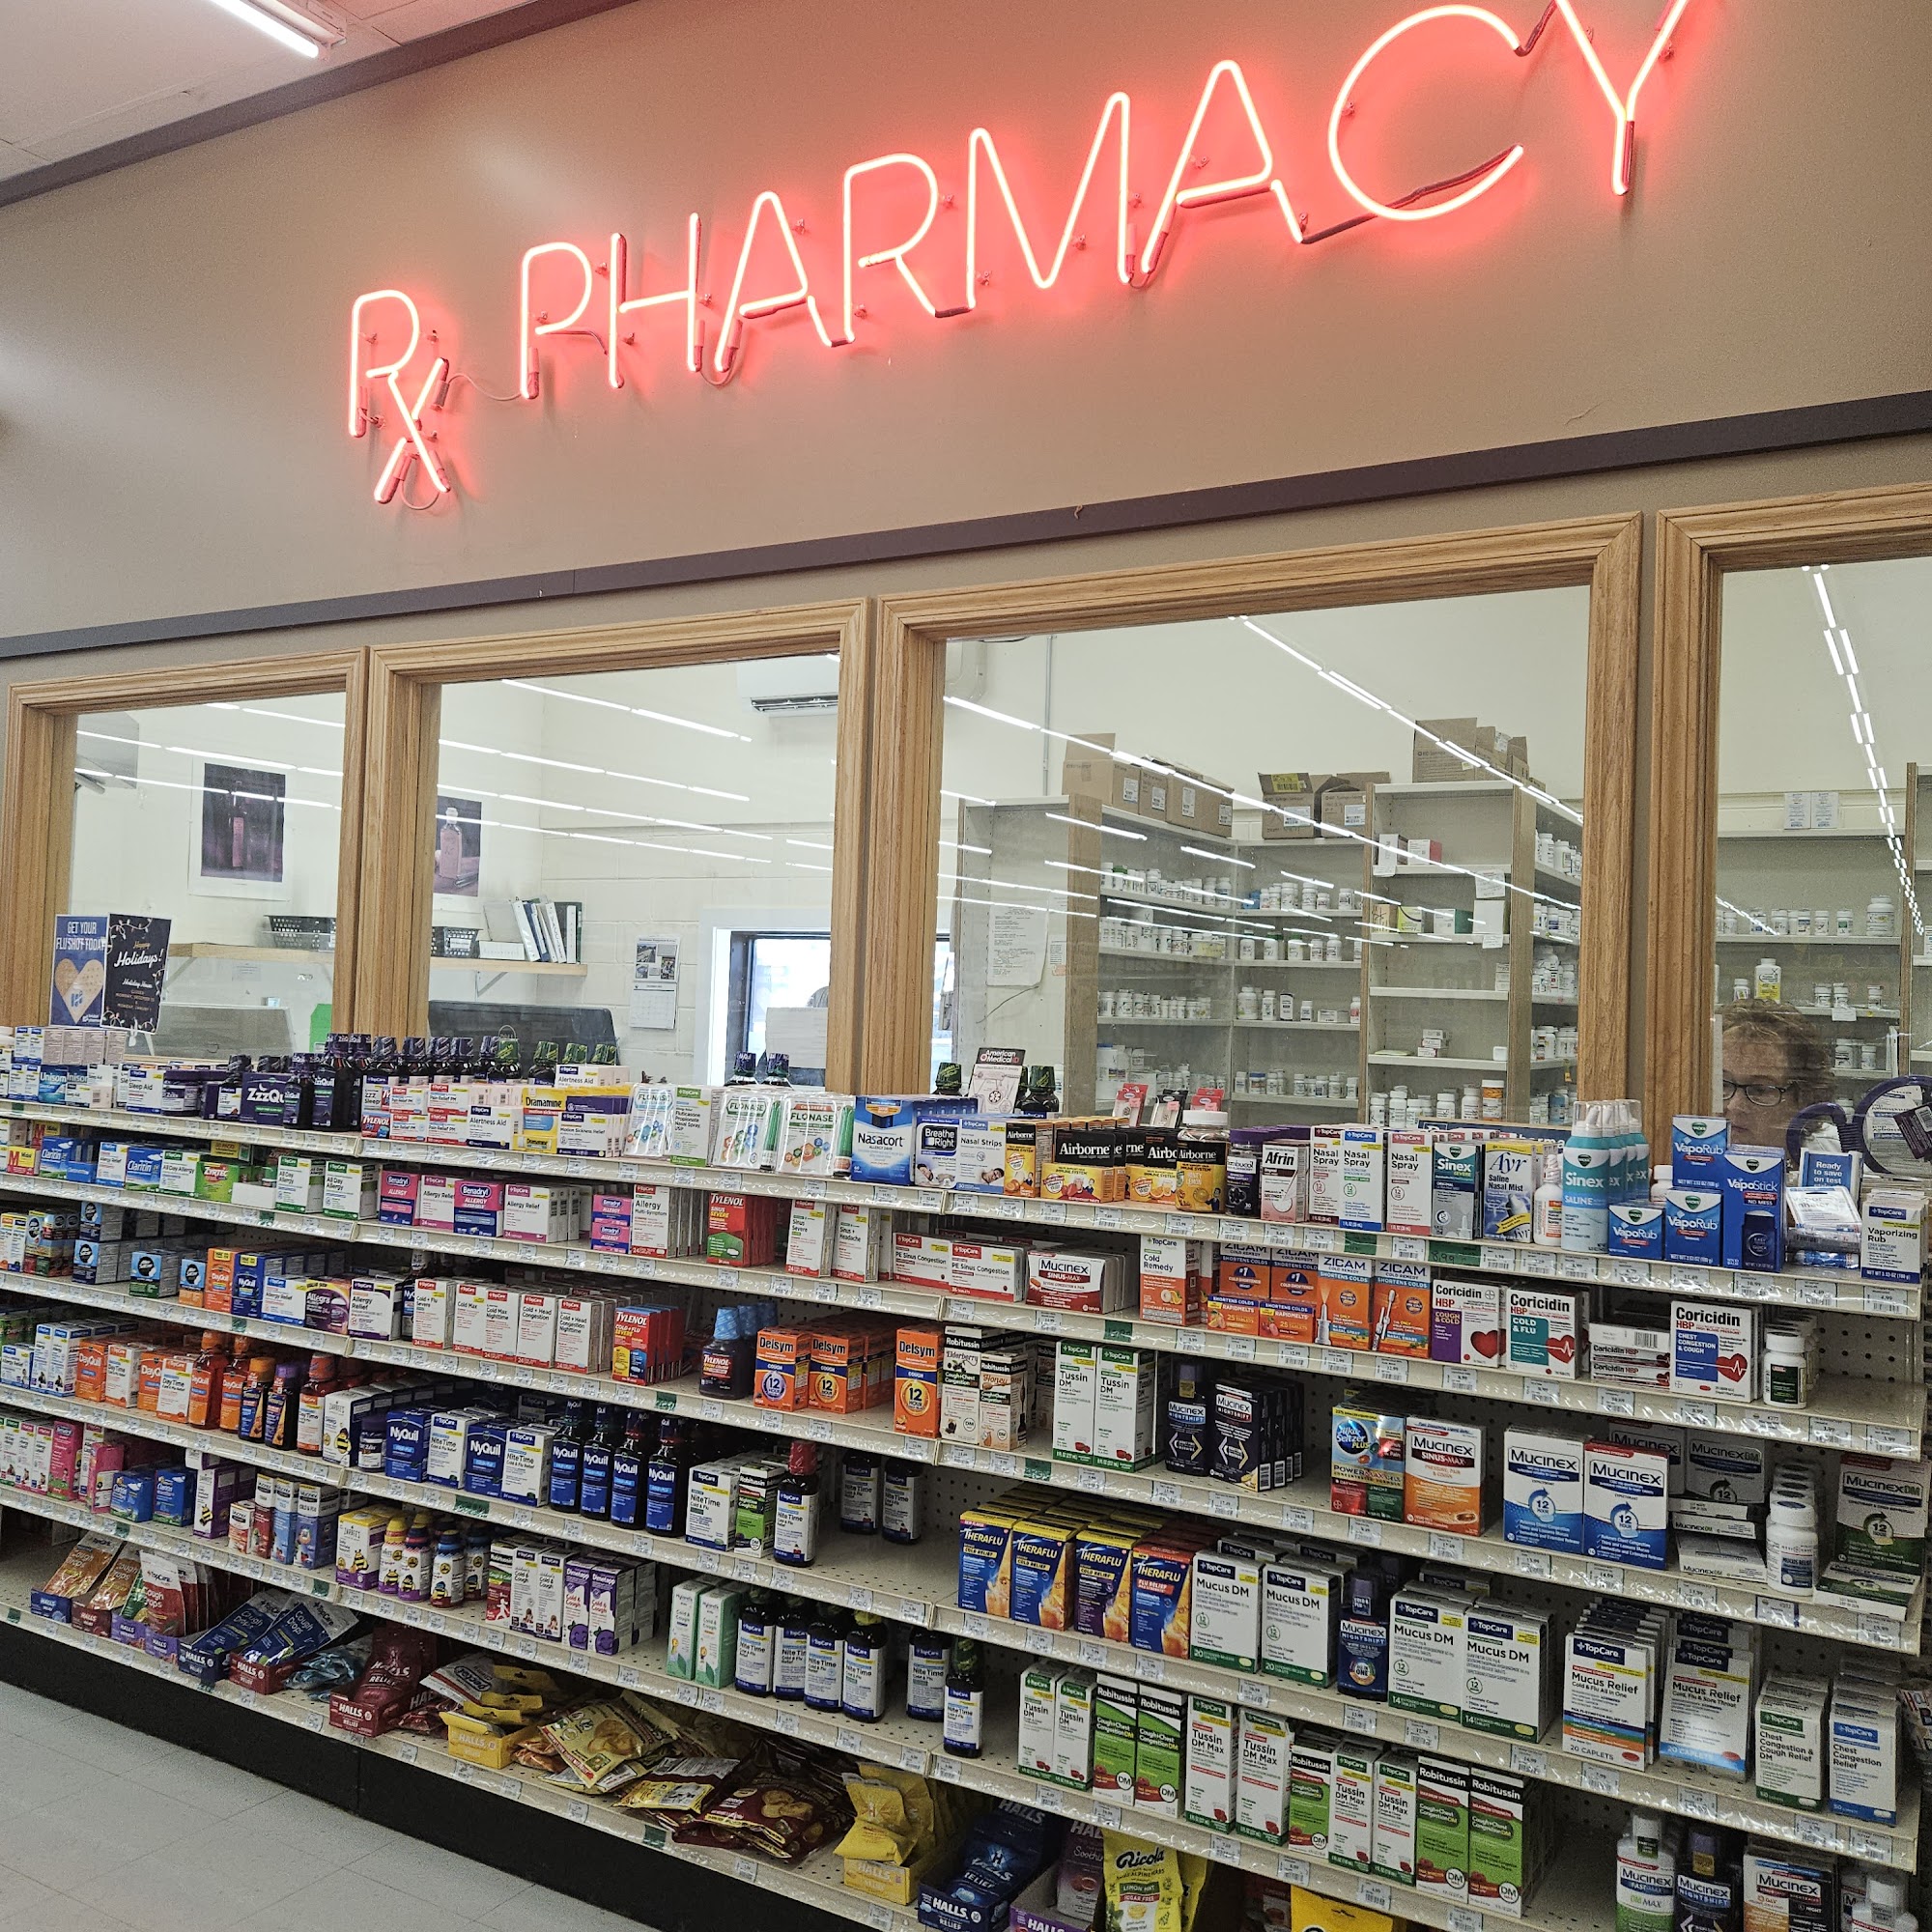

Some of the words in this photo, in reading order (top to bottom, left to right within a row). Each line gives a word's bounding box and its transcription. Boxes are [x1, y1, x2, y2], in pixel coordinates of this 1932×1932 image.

[520, 0, 1693, 401] PHARMACY
[68, 922, 78, 934] GET
[80, 922, 97, 935] YOUR
[56, 938, 68, 950] FLU
[114, 949, 164, 968] Holidays!
[41, 1072, 67, 1082] Unisom
[526, 1096, 562, 1109] Dramamine
[729, 1102, 765, 1112] FLONASE
[469, 1117, 495, 1126] Alertness
[790, 1113, 834, 1122] FLONASE
[858, 1132, 903, 1148] Nasacort
[924, 1128, 954, 1139] Breathe
[1008, 1130, 1035, 1139] Airborne
[934, 1137, 954, 1149] Right
[960, 1137, 979, 1146] Nasal
[980, 1139, 1002, 1148] Strips
[1059, 1142, 1110, 1155] Airborne
[1674, 1142, 1724, 1155] VapoRub
[1179, 1150, 1216, 1159] Airborne
[1265, 1151, 1294, 1167] Afrin
[1313, 1148, 1339, 1157] Nasal
[1344, 1150, 1370, 1159] Nasal
[1391, 1152, 1418, 1162] Nasal
[127, 1159, 152, 1174] Claritin
[1313, 1156, 1340, 1167] Spray
[1344, 1157, 1370, 1168] Spray
[1391, 1161, 1419, 1172] Spray
[1436, 1158, 1472, 1173] Sinex
[1490, 1152, 1526, 1174] Ayr
[1816, 1161, 1841, 1171] Ready
[204, 1166, 228, 1178] ZYRTEC
[327, 1182, 344, 1191] Allergy
[388, 1176, 410, 1186] Benadryl
[1488, 1181, 1507, 1191] Nasal
[1508, 1183, 1523, 1192] Mist
[1565, 1172, 1604, 1188] Sinex
[1727, 1179, 1778, 1192] VapoStick
[462, 1185, 490, 1196] Benadryl
[465, 1197, 488, 1206] ALLERGY
[506, 1201, 525, 1210] Allergy
[636, 1200, 662, 1210] Allergy
[711, 1193, 744, 1207] TYLENOL
[1564, 1195, 1593, 1206] SALINE
[1668, 1214, 1718, 1230] VapoRub
[1612, 1225, 1658, 1239] VapoRub
[1867, 1227, 1918, 1240] Vaporizing
[1867, 1235, 1887, 1243] Rub
[1144, 1254, 1160, 1263] Cold
[1323, 1257, 1366, 1270] ZICAM
[977, 1265, 1009, 1276] Congestion
[1144, 1262, 1174, 1273] Remedy
[1379, 1263, 1426, 1276] ZICAM
[1320, 1271, 1347, 1280] SHORTENS
[1435, 1285, 1482, 1299] Coricidin
[352, 1296, 373, 1305] Allergy
[1435, 1297, 1455, 1308] HBP
[1510, 1293, 1570, 1312] Coricidin
[1510, 1306, 1527, 1315] HBP
[1676, 1306, 1741, 1326] Coricidin
[616, 1312, 647, 1325] TYLENOL
[1512, 1317, 1536, 1327] COLD
[1676, 1320, 1695, 1329] HBP
[1520, 1325, 1536, 1335] FLU
[759, 1336, 794, 1352] Delsym
[812, 1338, 846, 1354] Delsym
[899, 1341, 935, 1358] Delsym
[946, 1337, 980, 1350] Robitussin
[1678, 1340, 1717, 1350] CONGESTION
[79, 1354, 101, 1368] DayQuil
[1100, 1385, 1113, 1394] DM
[1101, 1378, 1130, 1389] Tussin
[908, 1388, 922, 1401] 12
[1169, 1411, 1206, 1424] NIGHTSHIFT
[390, 1426, 419, 1441] NyQuil
[469, 1441, 501, 1457] NyQuil
[614, 1460, 638, 1475] NyQuil
[649, 1468, 674, 1482] NyQuil
[964, 1528, 1004, 1546] THERAFLU
[1137, 1561, 1180, 1582] THERAFLU
[1208, 1563, 1231, 1575] TopCare
[592, 1574, 615, 1585] Dimetapp
[1196, 1577, 1229, 1594] Mucus
[1232, 1586, 1249, 1598] DM
[1406, 1605, 1435, 1618] TopCare
[1394, 1624, 1432, 1639] Mucus
[1434, 1633, 1454, 1645] DM
[1194, 1649, 1204, 1658] 20
[1584, 1642, 1619, 1658] TopCare
[1687, 1651, 1722, 1665] TopCare
[237, 1662, 257, 1676] HALLS
[1572, 1671, 1605, 1689] Mucus
[1606, 1679, 1638, 1694] Relief
[1097, 1688, 1136, 1704] Robitussin
[1672, 1681, 1706, 1696] Mucus
[1710, 1689, 1741, 1703] Relief
[1391, 1695, 1401, 1705] 14
[339, 1702, 363, 1718] HALLS
[1141, 1698, 1180, 1717] Robitussin
[343, 1719, 359, 1727] RELIEF
[1192, 1729, 1223, 1745] Tussin
[1760, 1730, 1783, 1742] Chest
[1192, 1739, 1205, 1747] DM
[1208, 1743, 1225, 1754] Max
[1760, 1738, 1805, 1754] Congestion
[1833, 1744, 1857, 1754] Chest
[1581, 1747, 1614, 1762] CAPLETS
[1760, 1746, 1787, 1758] Cough
[1789, 1751, 1812, 1762] Relief
[1760, 1752, 1773, 1762] DM
[1833, 1750, 1882, 1768] Congestion
[1833, 1759, 1858, 1770] Relief
[1117, 1776, 1132, 1785] DM
[1419, 1766, 1466, 1787] Robitussin
[1471, 1778, 1521, 1801] Robitussin
[1116, 1847, 1165, 1868] Ricola
[1500, 1888, 1517, 1898] DM
[933, 1898, 967, 1918] HALLS
[939, 1918, 961, 1930] RELIEF
